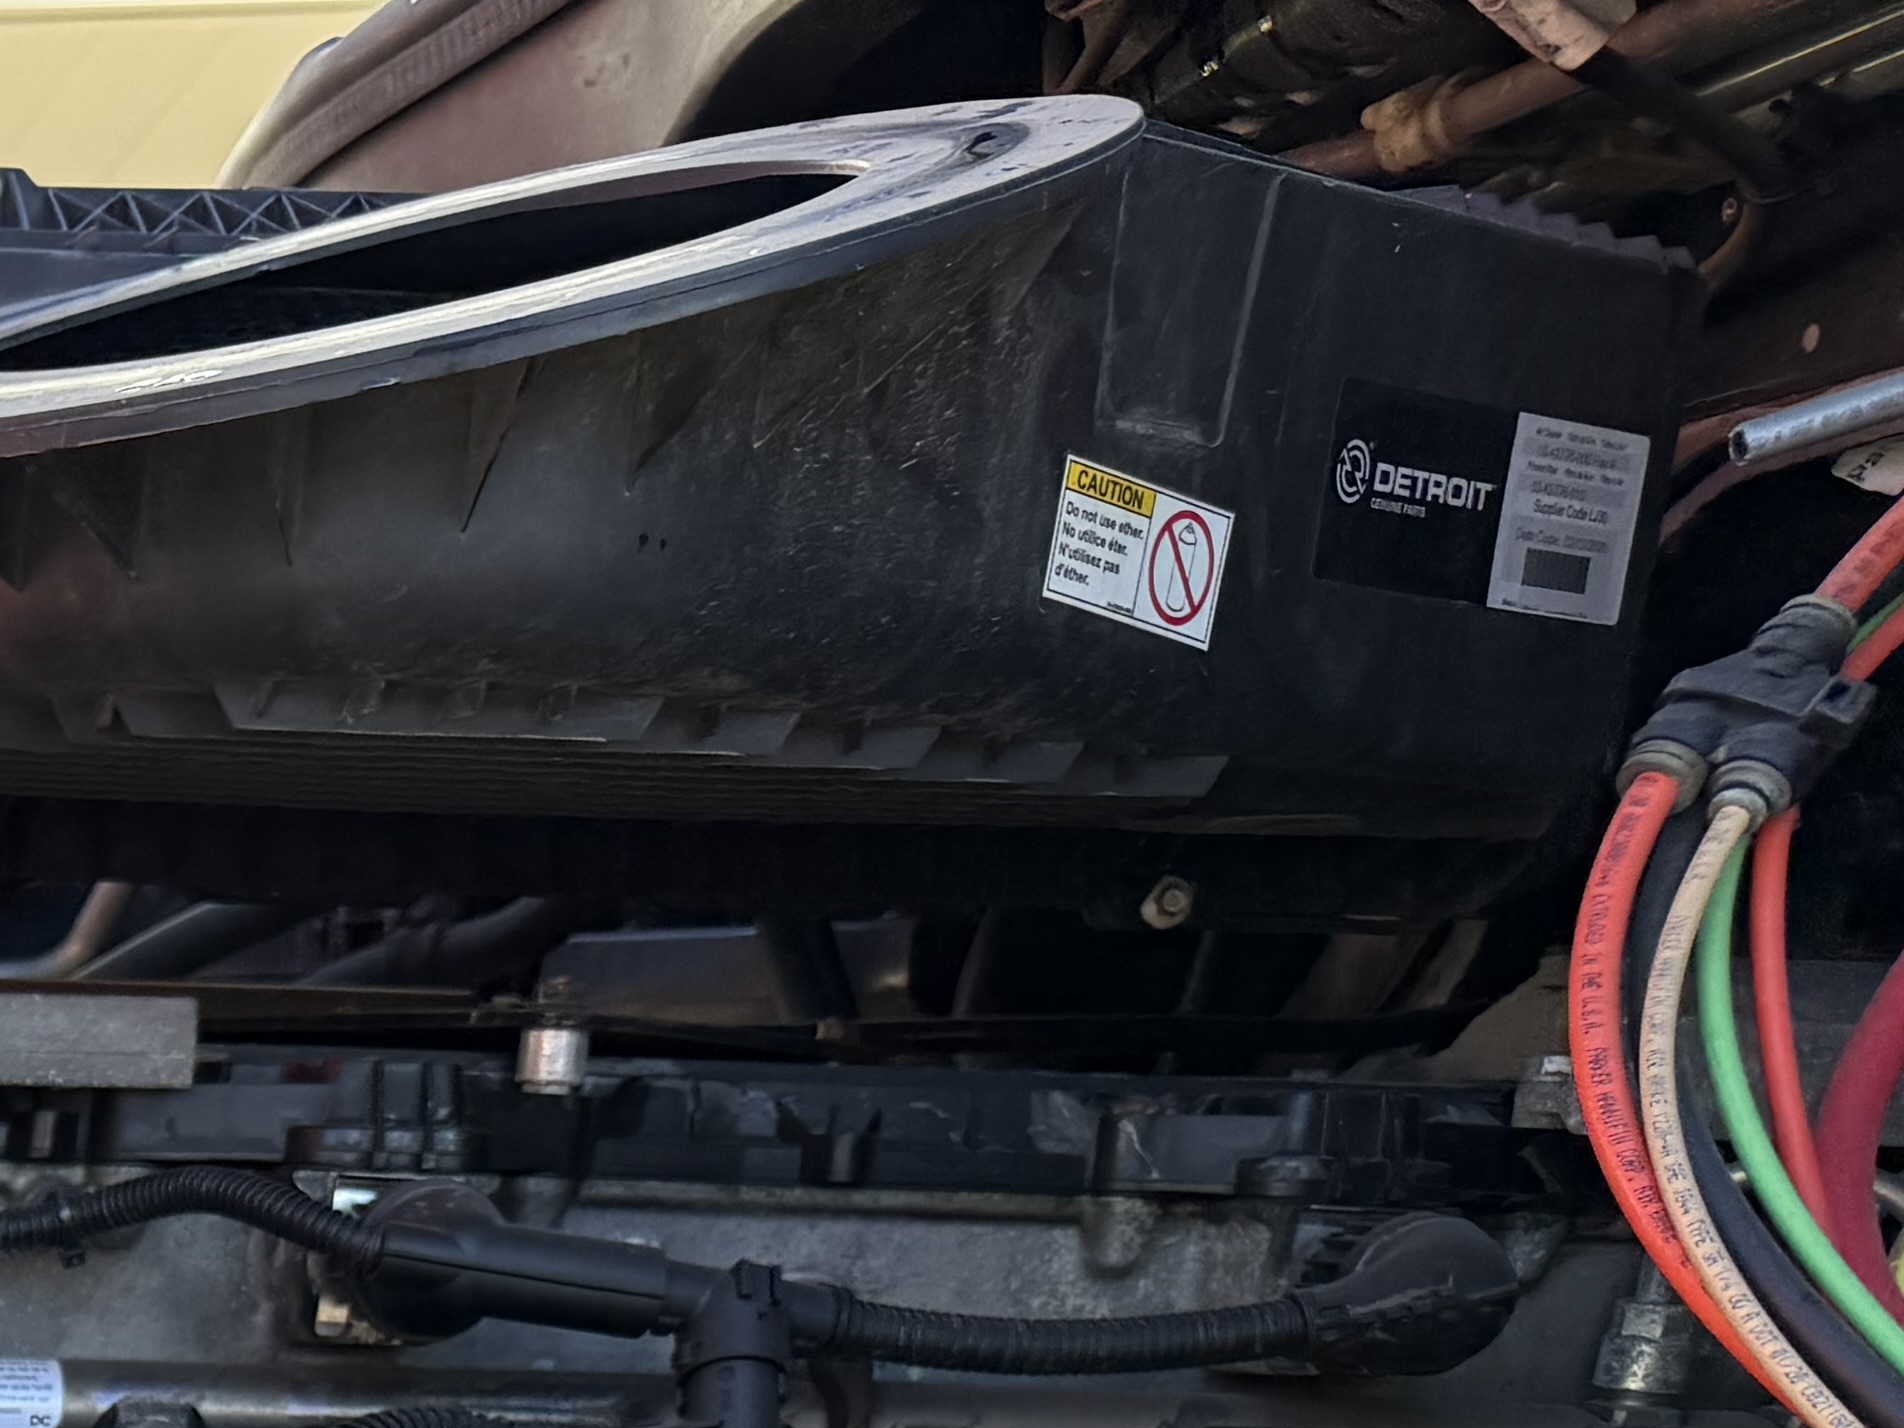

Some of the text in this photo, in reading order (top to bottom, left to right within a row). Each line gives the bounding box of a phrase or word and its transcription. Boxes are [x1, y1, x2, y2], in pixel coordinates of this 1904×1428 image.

[1078, 469, 1145, 511] CAUTION
[1373, 462, 1492, 510] DETROIT
[1062, 521, 1076, 538] No
[1066, 501, 1144, 540] Do not use ether.
[1103, 560, 1120, 576] pas
[29, 1415, 52, 1428] DC
